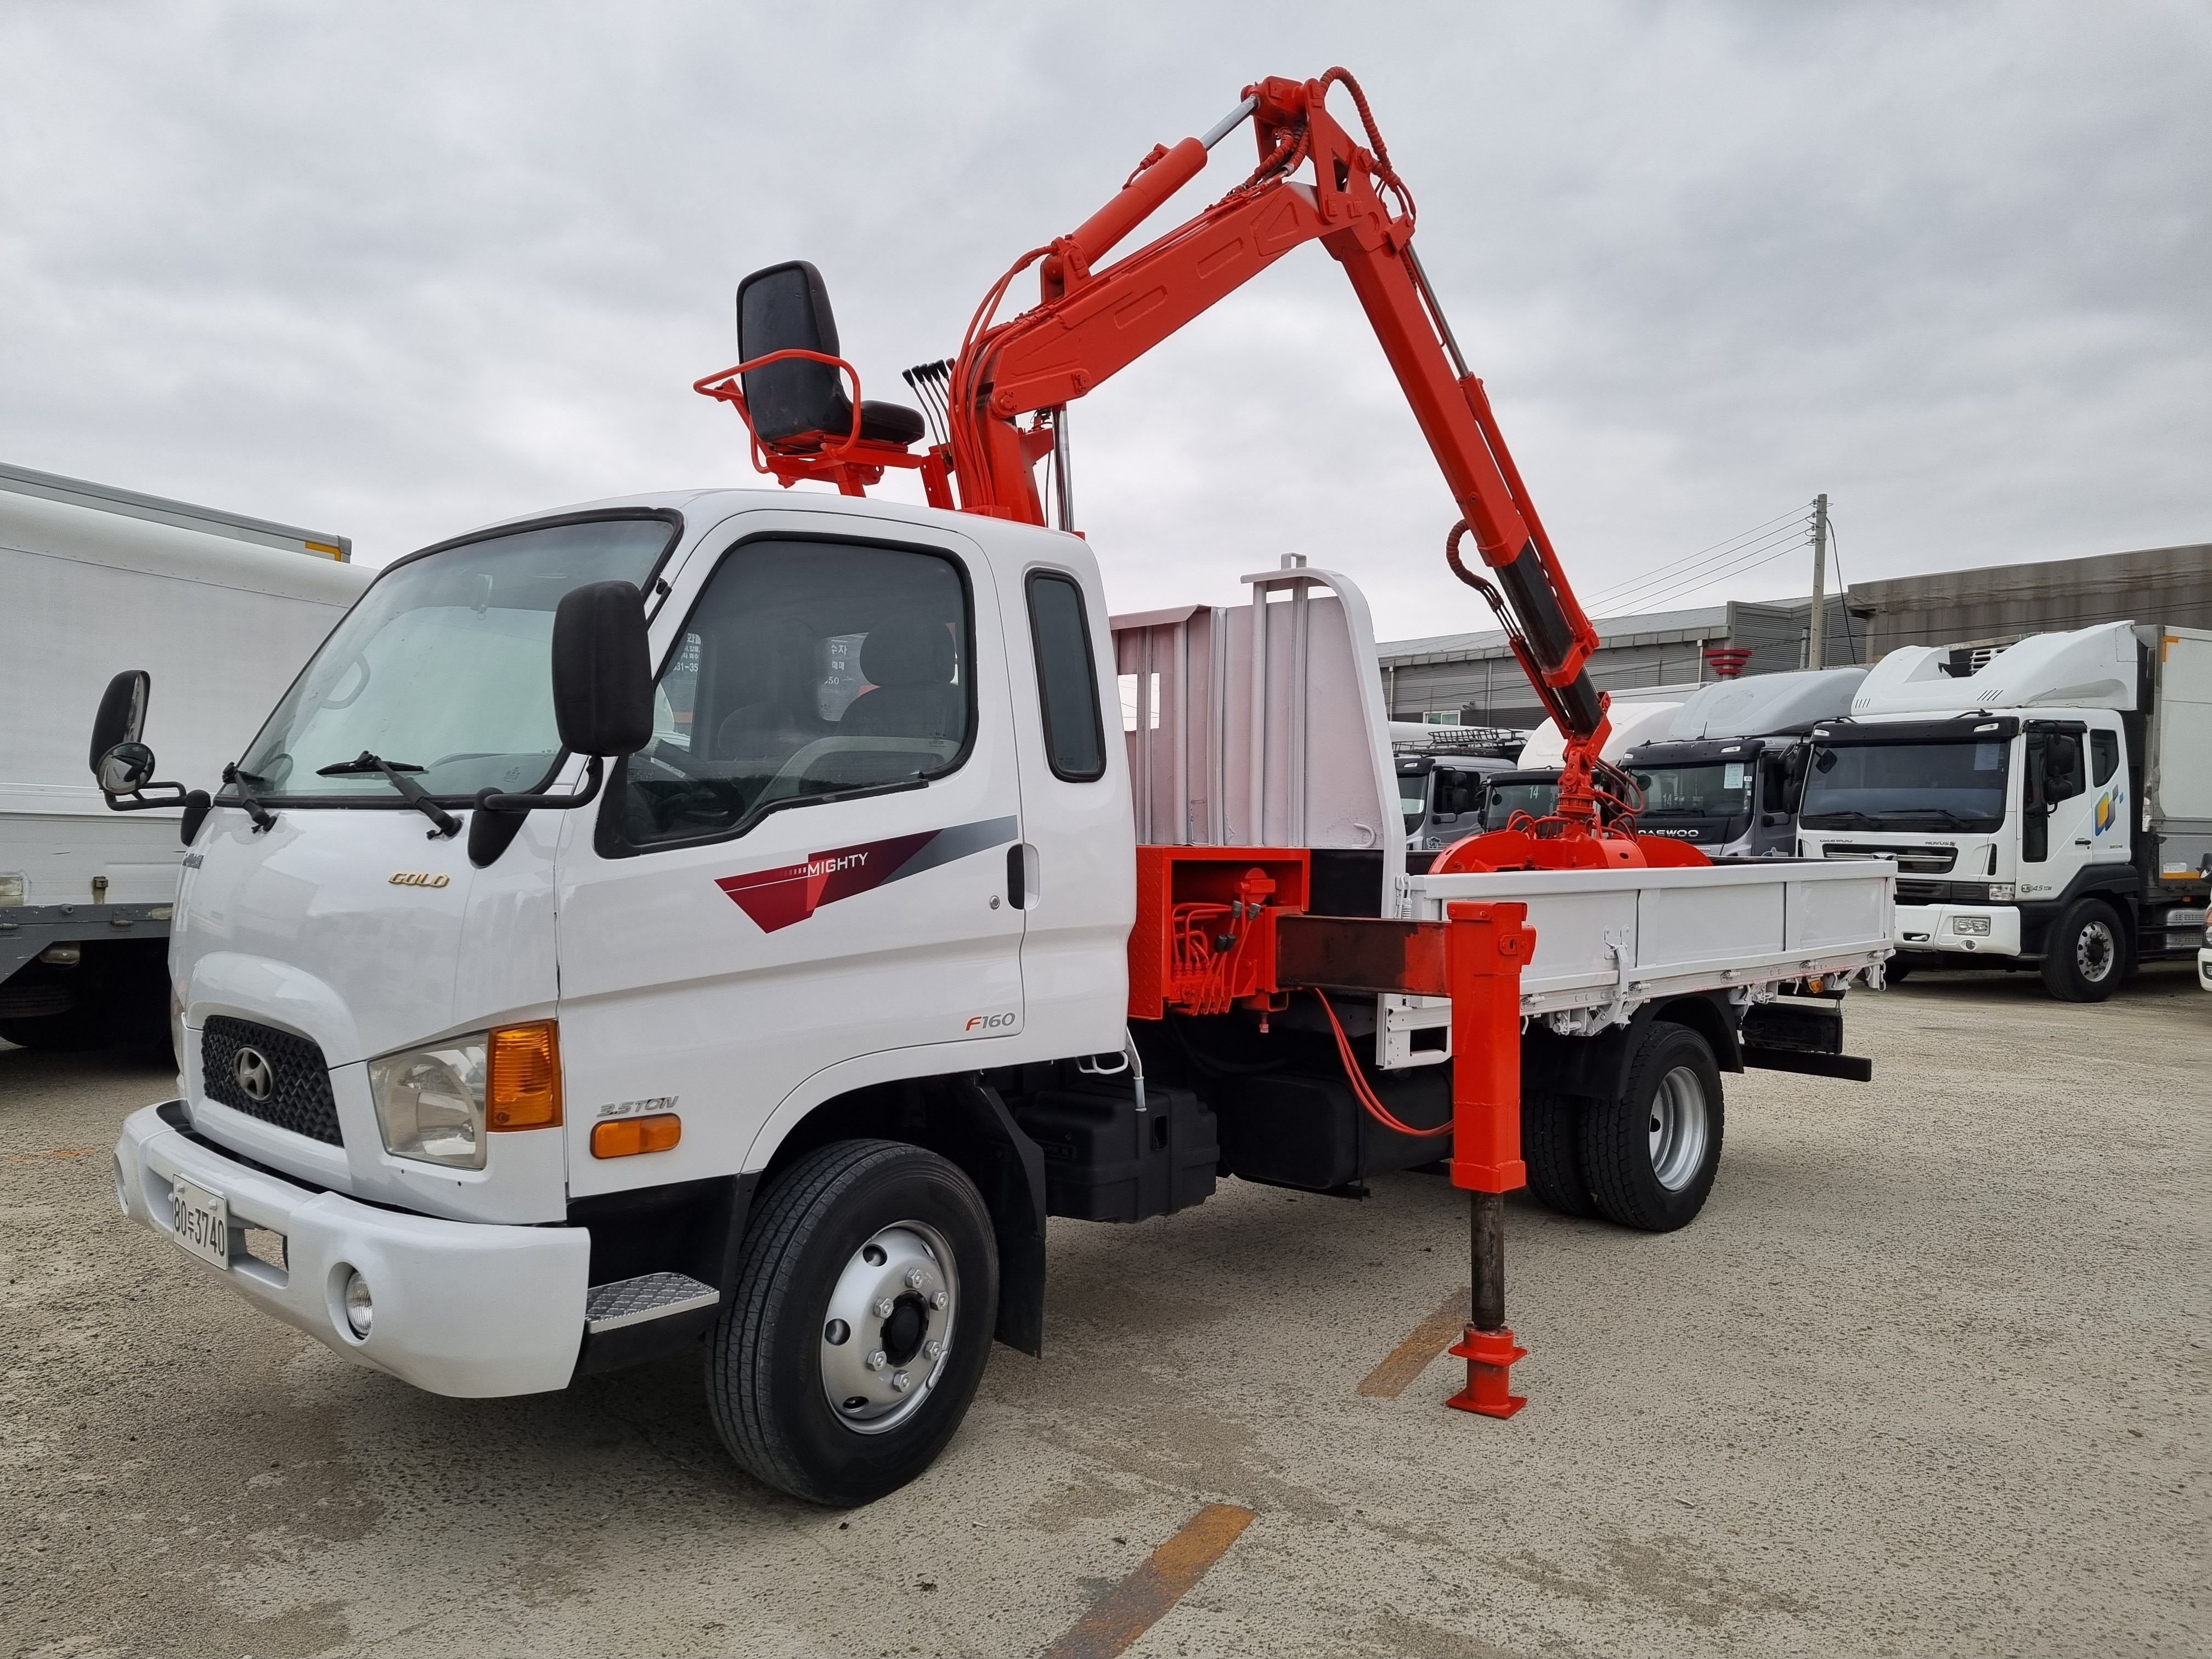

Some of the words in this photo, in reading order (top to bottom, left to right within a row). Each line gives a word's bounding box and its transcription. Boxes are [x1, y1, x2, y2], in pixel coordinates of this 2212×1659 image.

[808, 852, 868, 876] MIGHTY
[388, 872, 449, 888] GOLD
[966, 1012, 1015, 1031] F160
[174, 1197, 224, 1256] 80두3740
